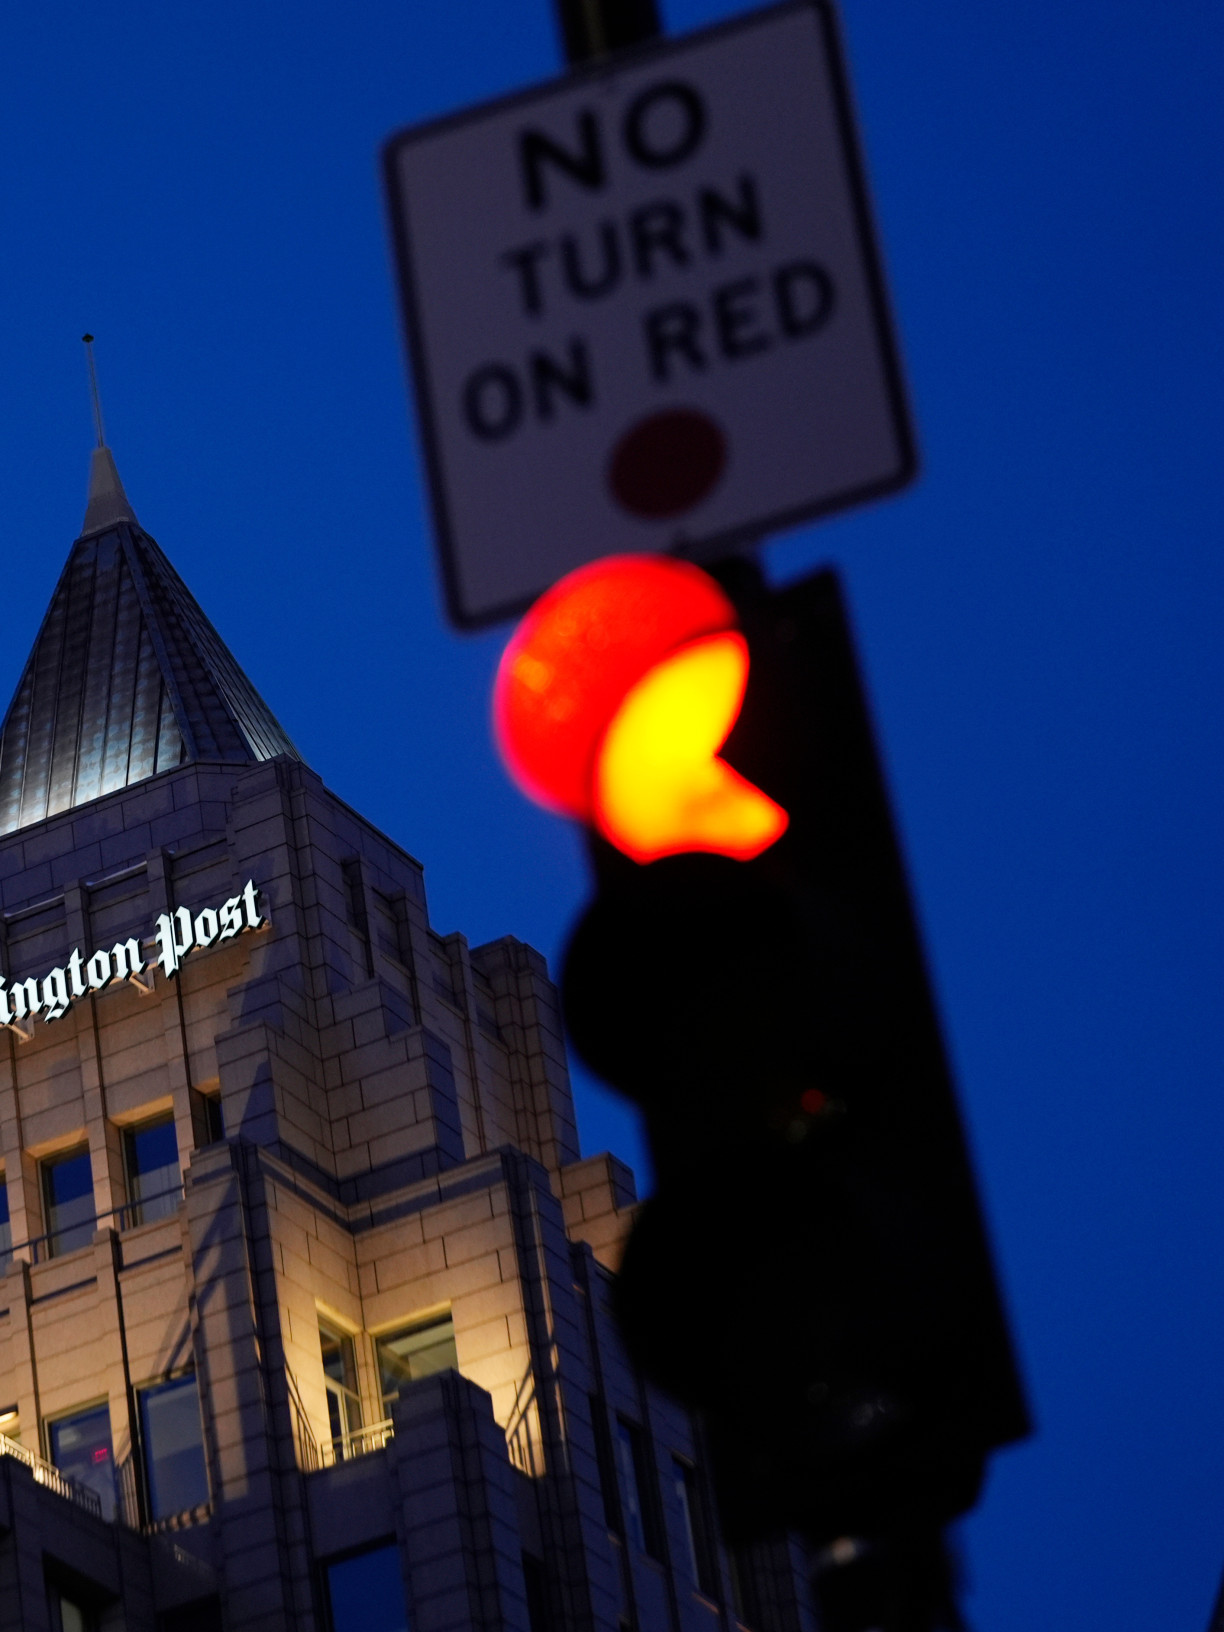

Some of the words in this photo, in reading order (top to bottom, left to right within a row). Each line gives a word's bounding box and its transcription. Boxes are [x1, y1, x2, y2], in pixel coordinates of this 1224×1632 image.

[519, 82, 705, 211] NO
[502, 172, 761, 316] TURN
[464, 338, 592, 442] ON
[645, 261, 834, 383] RED
[154, 878, 266, 980] Post
